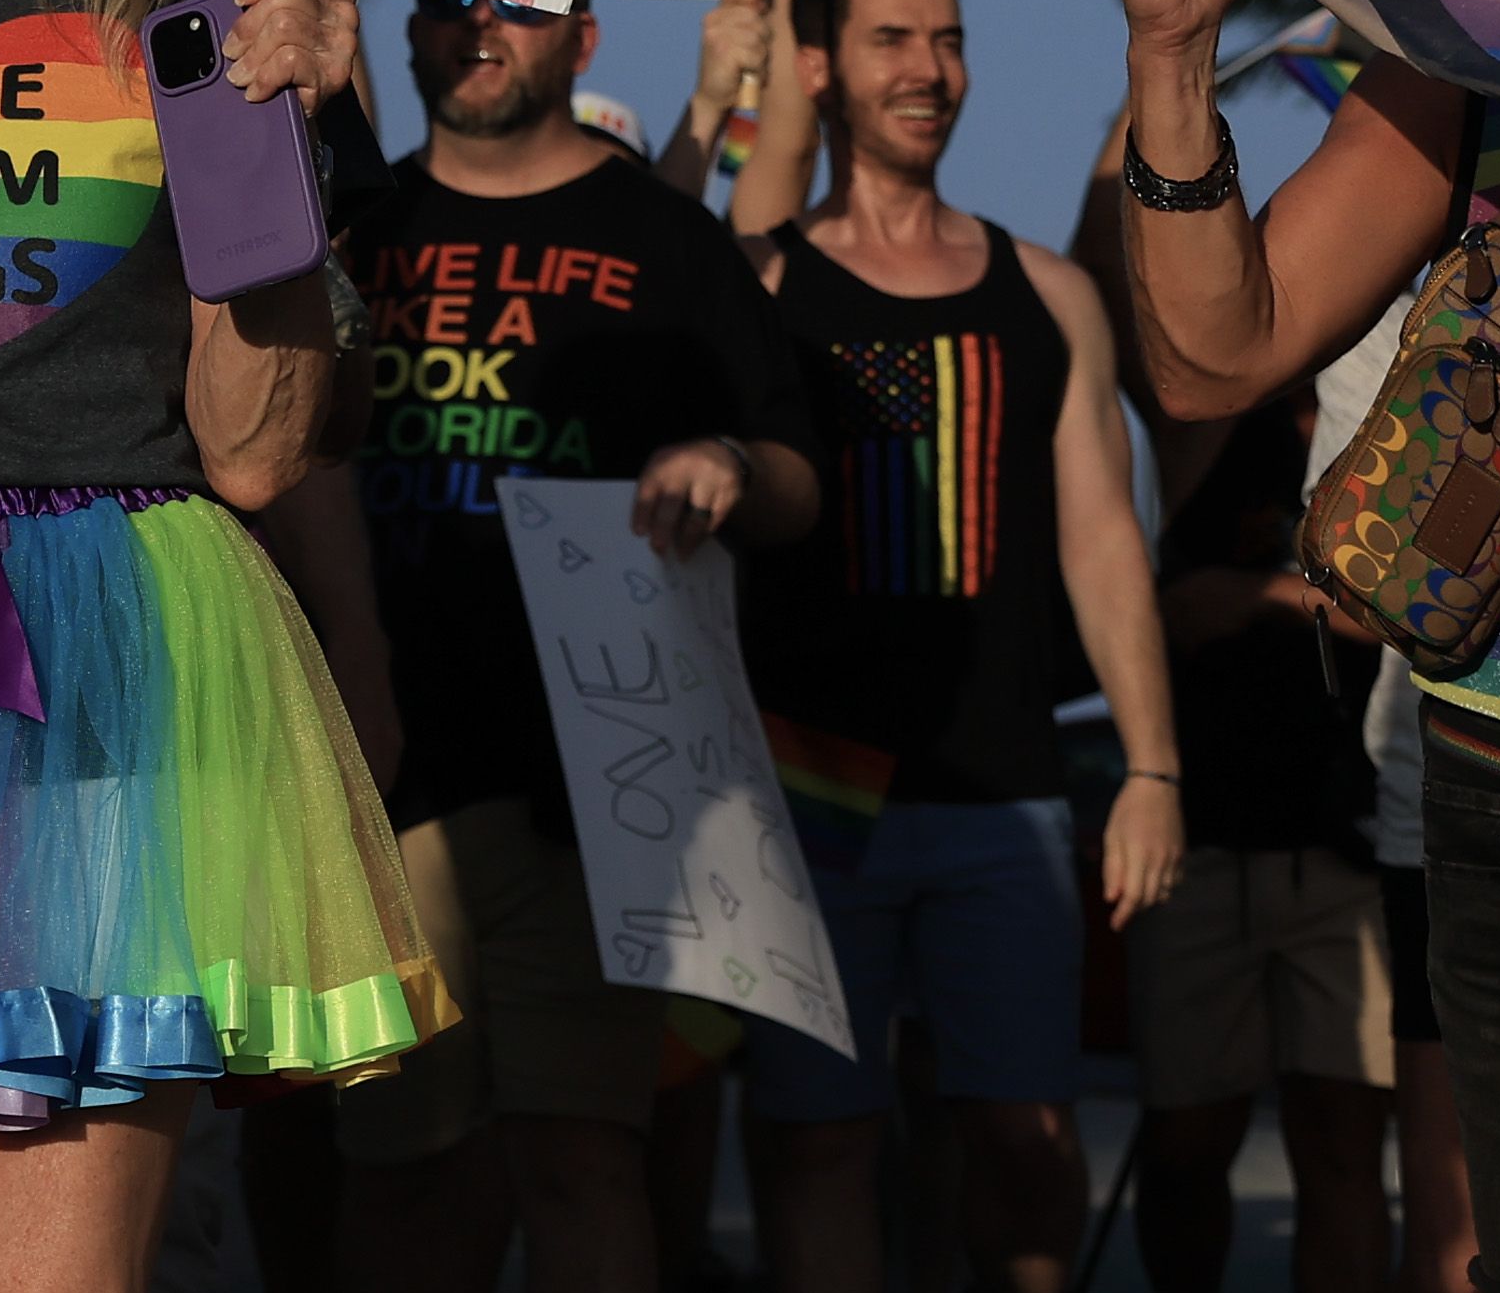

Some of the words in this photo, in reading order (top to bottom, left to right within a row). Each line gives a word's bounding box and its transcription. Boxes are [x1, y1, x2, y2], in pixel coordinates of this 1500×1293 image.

[495, 242, 641, 312] LIFE
[366, 292, 475, 346] IKE
[485, 293, 539, 347] A
[372, 344, 519, 402] OOK
[362, 401, 595, 474] ORIDA
[556, 625, 704, 940] LOVE
